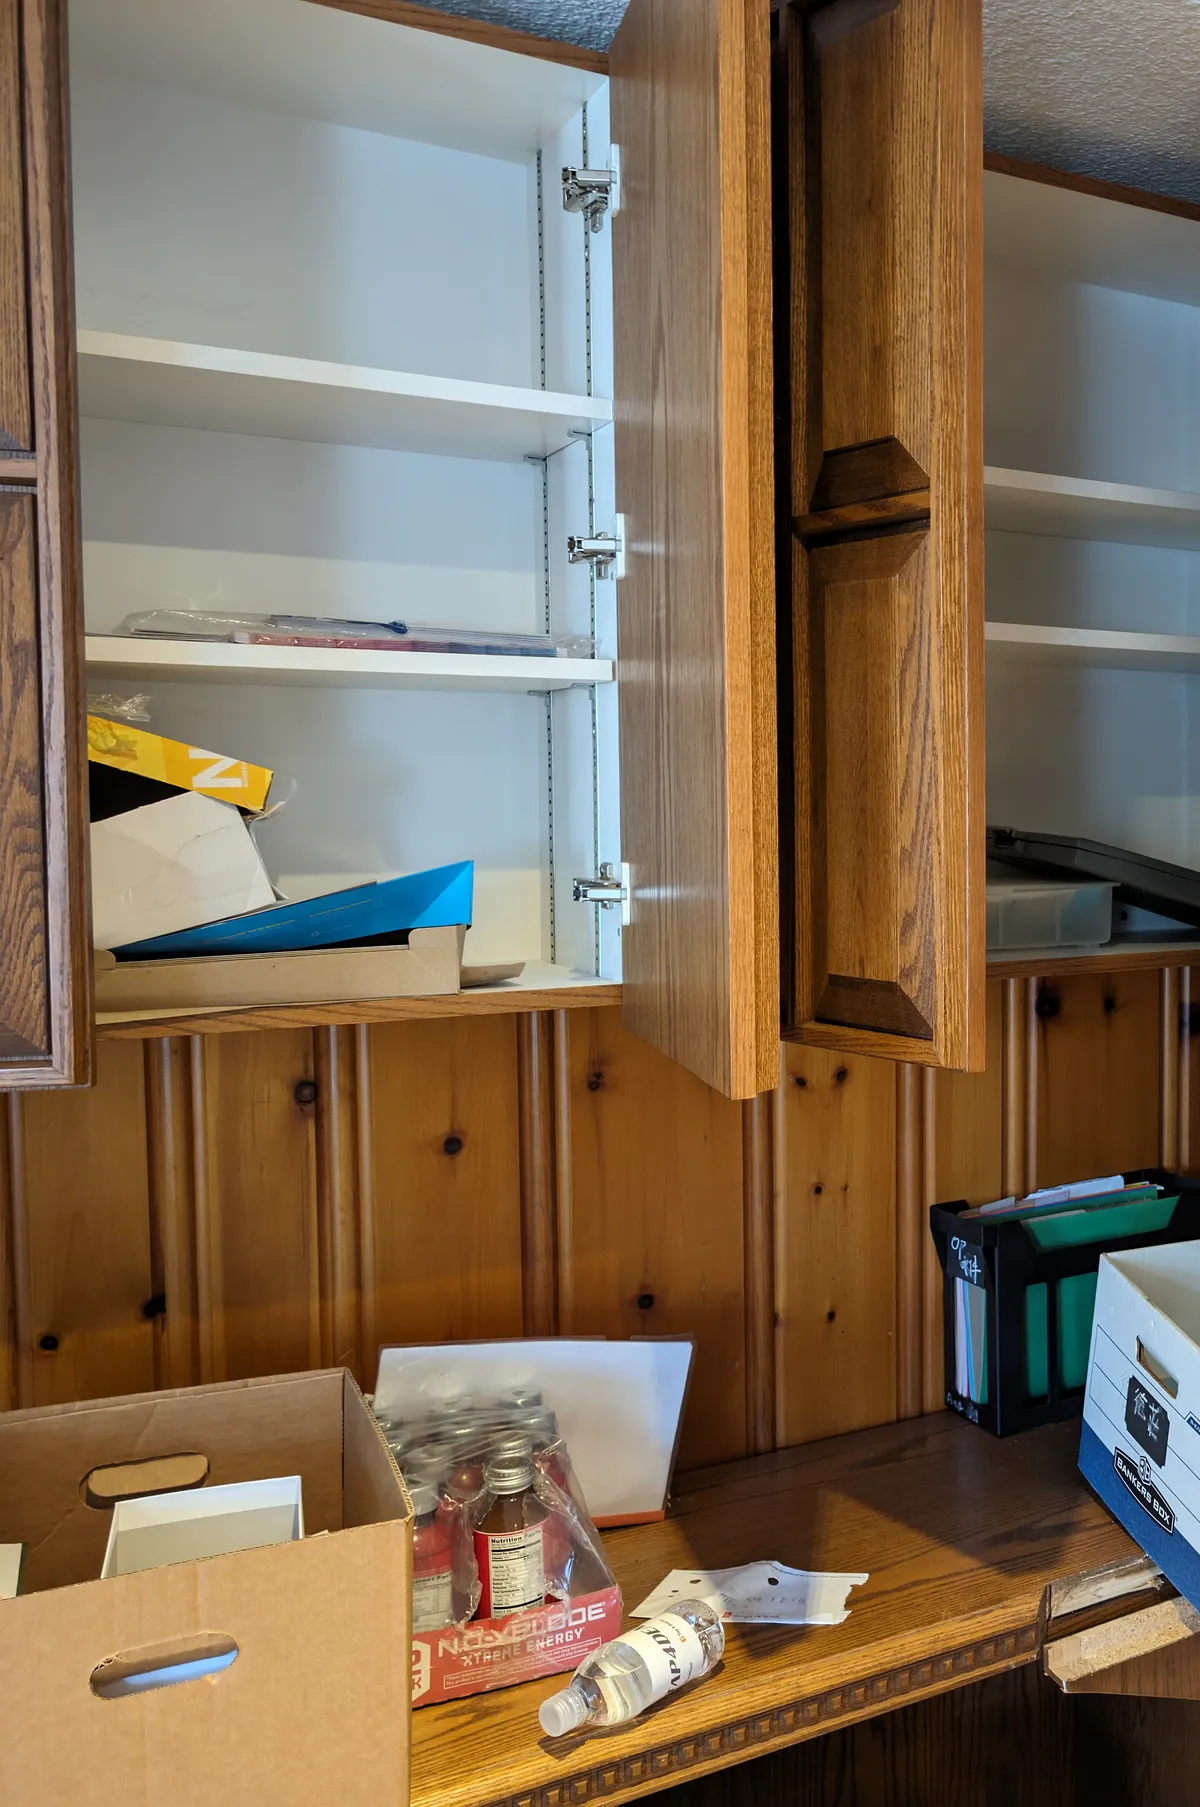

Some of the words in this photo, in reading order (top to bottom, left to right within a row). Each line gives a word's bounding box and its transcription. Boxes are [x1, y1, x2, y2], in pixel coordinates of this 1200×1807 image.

[1116, 1457, 1152, 1504] BANKERS
[1153, 1499, 1170, 1526] BOX
[491, 1536, 522, 1544] Nutrition
[463, 1644, 523, 1667] XTREME
[526, 1629, 584, 1652] ENERGY
